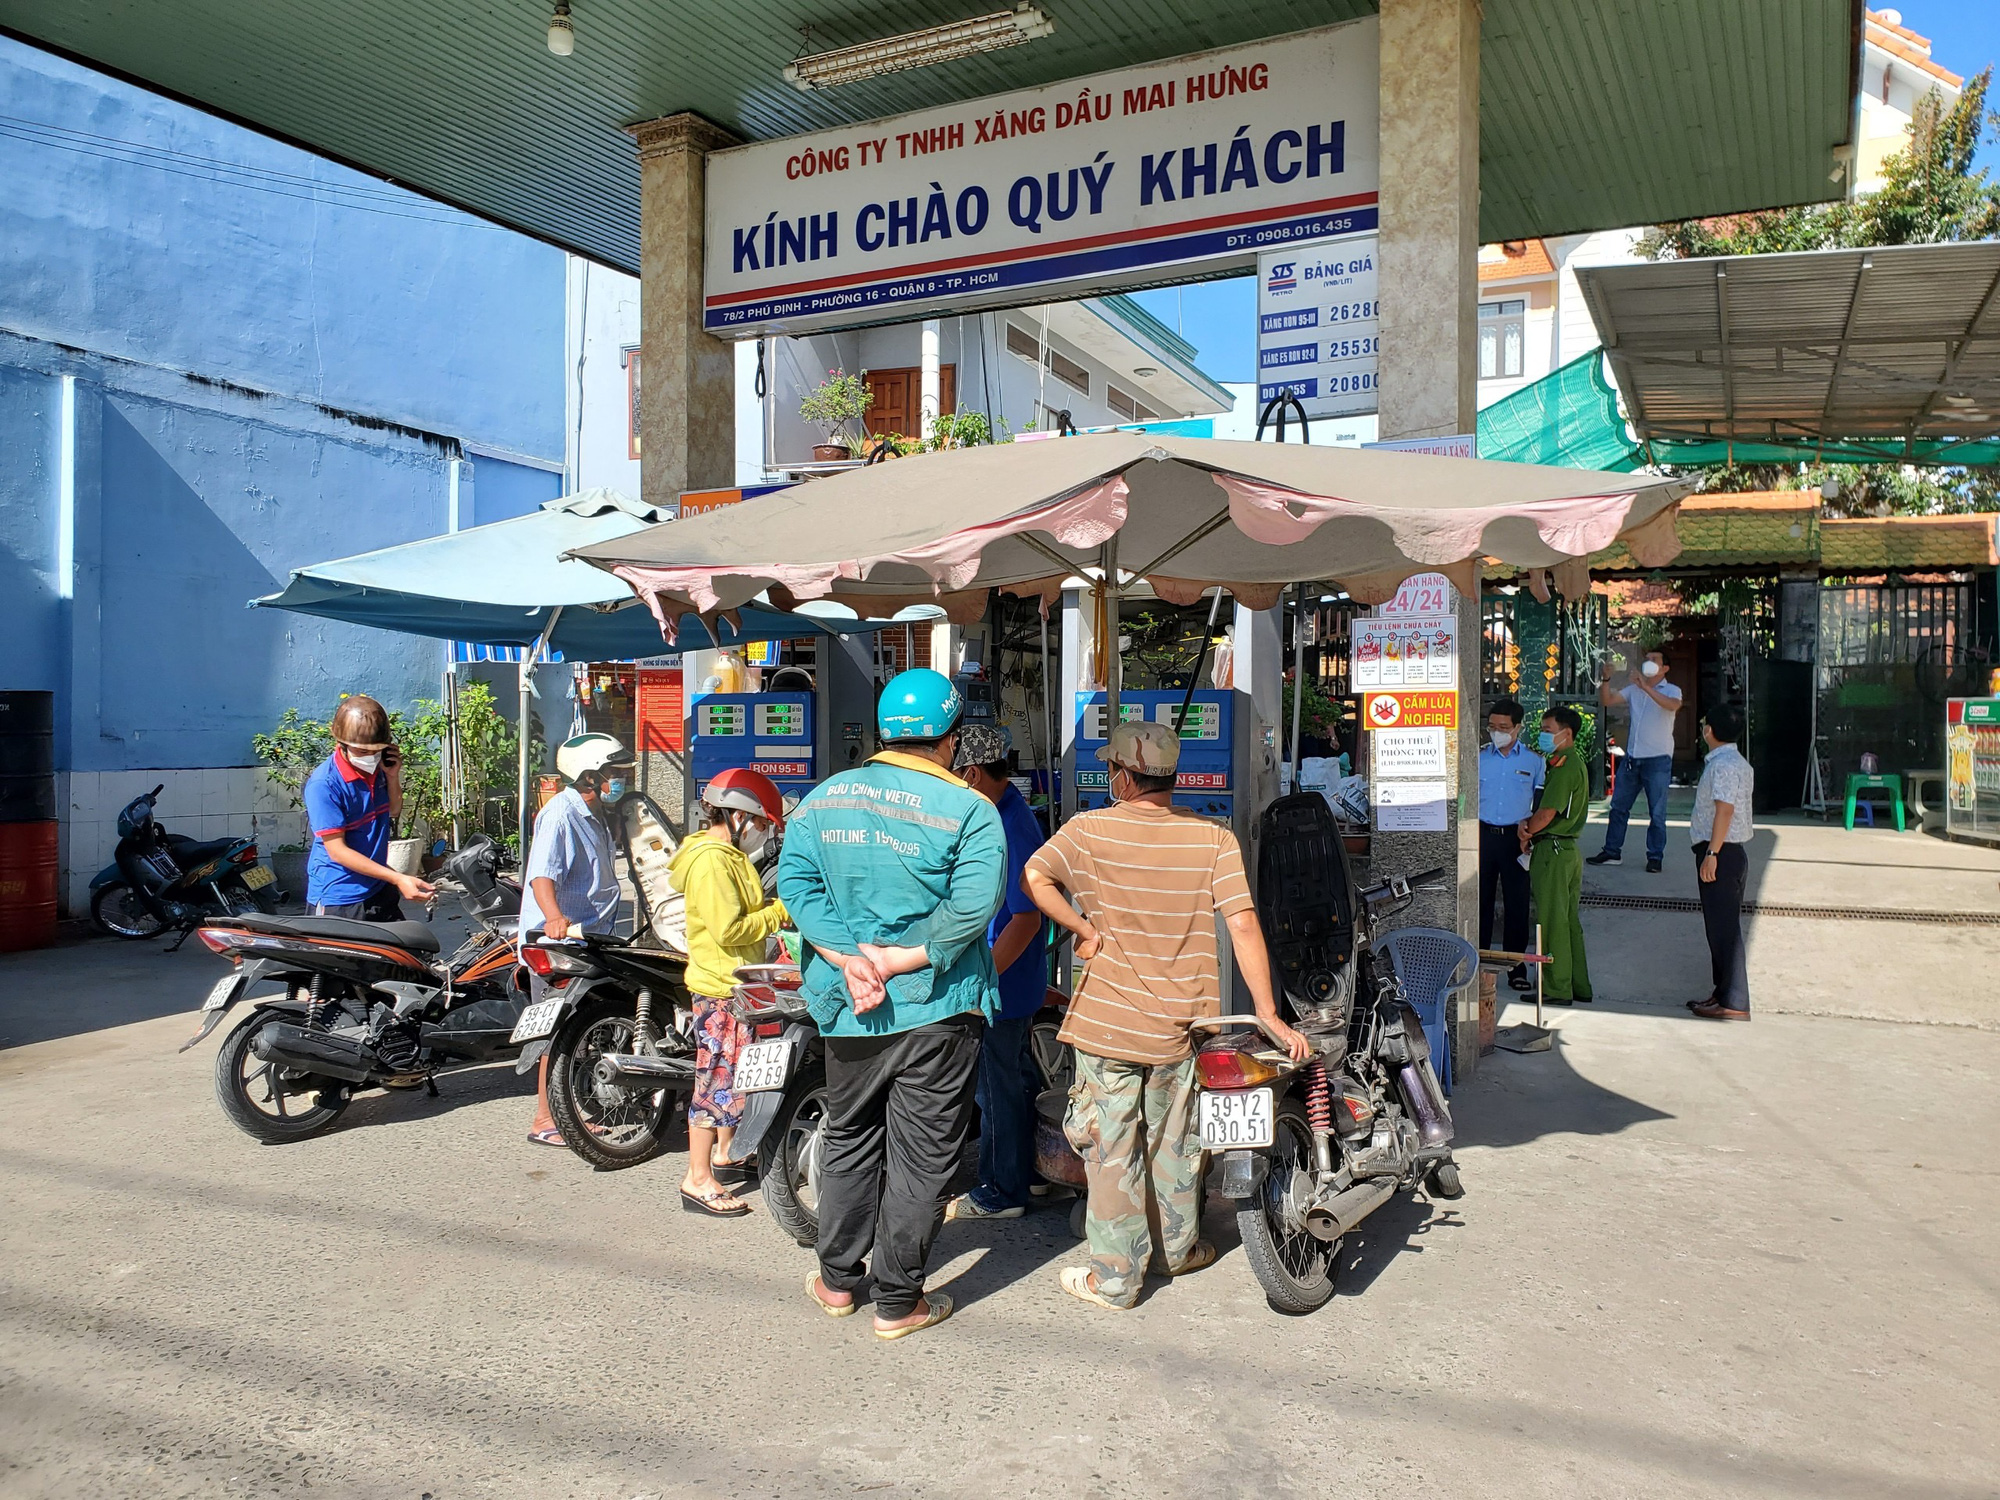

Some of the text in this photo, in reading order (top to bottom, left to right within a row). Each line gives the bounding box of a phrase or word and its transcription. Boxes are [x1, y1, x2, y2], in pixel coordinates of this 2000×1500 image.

[786, 64, 1268, 180] CÔNG TY TNHH XĂNG DẦU MAI HƯNG
[733, 120, 1345, 273] KÍNH CHÀO QUÝ KHÁCH
[1226, 218, 1352, 246] ĐT: 0908.016.435
[1304, 254, 1373, 280] BẢNG GIÁ
[723, 310, 745, 322] 78/2
[747, 305, 771, 318] PHÚ
[774, 302, 801, 315] ĐỊNH
[811, 292, 862, 309] PHƯỜNG
[865, 290, 879, 301] 16
[889, 282, 925, 297] QUẬN
[928, 282, 936, 292] 8
[946, 278, 966, 289] TP.
[969, 272, 999, 286] HCM
[1283, 315, 1297, 327] RON
[1330, 301, 1379, 321] 26280
[1280, 351, 1287, 363] E5
[1289, 350, 1301, 362] RON
[1330, 337, 1379, 358] 25530
[1330, 372, 1379, 393] 20800
[1262, 387, 1275, 399] DO
[1422, 574, 1444, 586] HÀNG
[1403, 693, 1452, 709] CẤM LỬA
[1404, 713, 1451, 725] NO FIRE
[1384, 738, 1404, 746] CHO
[753, 764, 806, 773] RON 95-III
[1081, 773, 1109, 784] E5 RO
[1188, 776, 1223, 786] 95-III
[885, 789, 923, 808] VIETTEL
[822, 829, 870, 844] HOTLINE:
[525, 1002, 556, 1022] 59-C1
[515, 1018, 553, 1039] 629.46
[746, 1044, 782, 1066] 59-L2
[736, 1065, 782, 1089] 662.69
[1211, 1094, 1261, 1119] 59-Y2
[1207, 1118, 1266, 1143] 030.51
